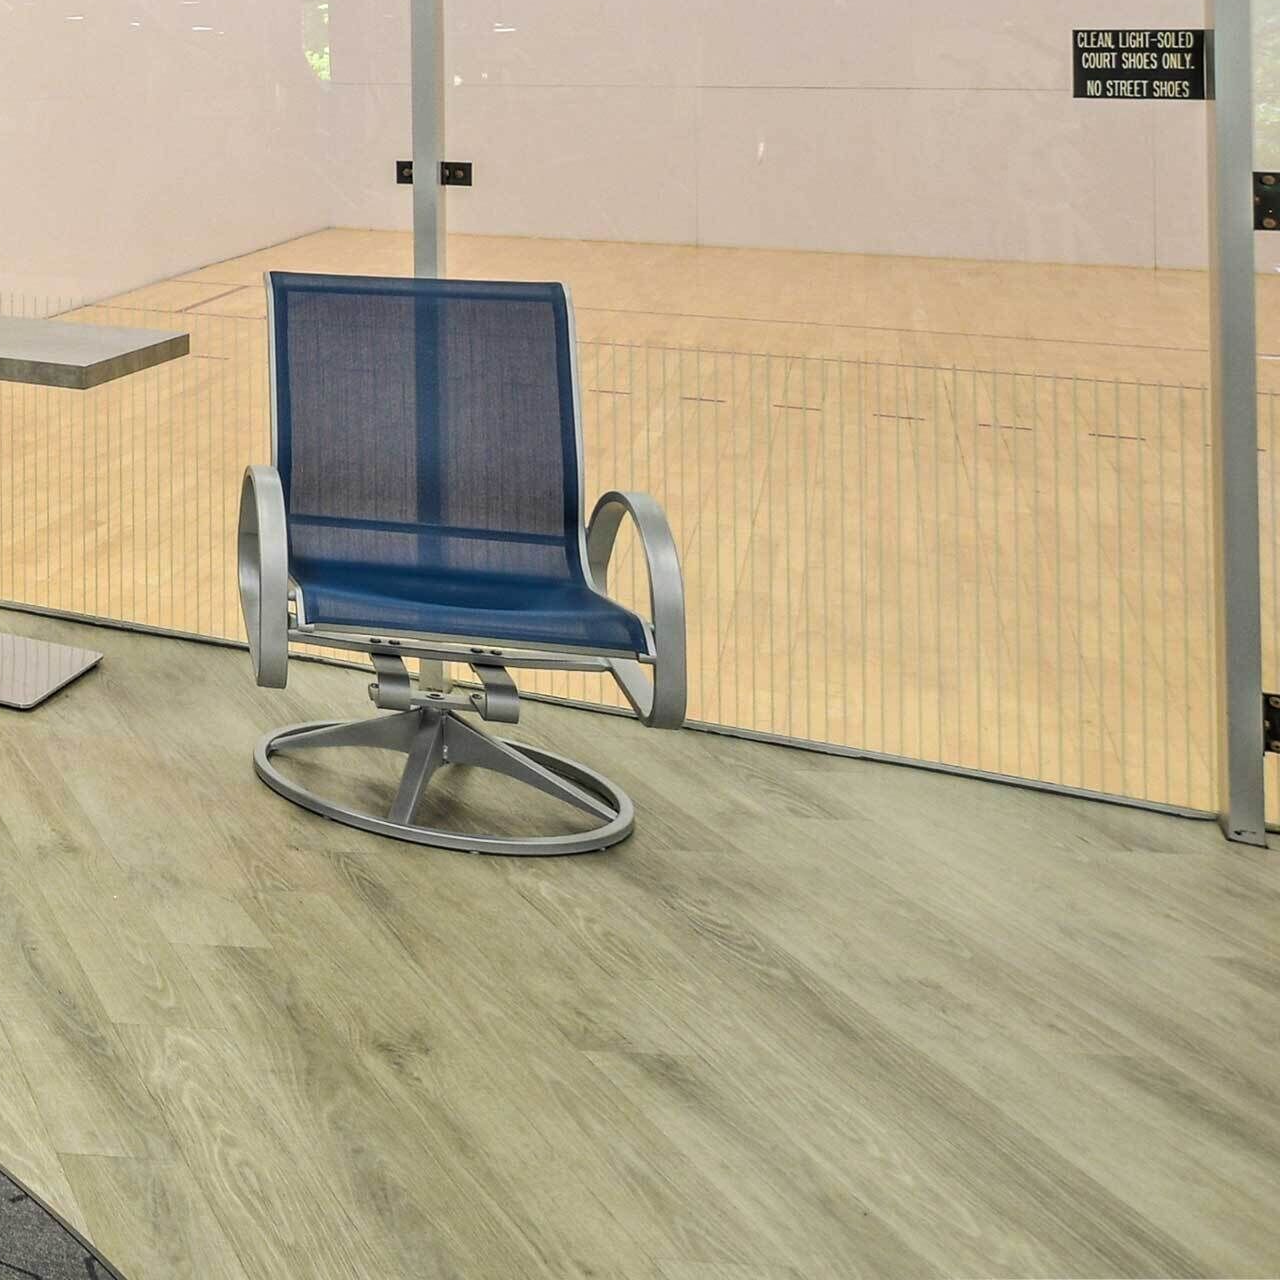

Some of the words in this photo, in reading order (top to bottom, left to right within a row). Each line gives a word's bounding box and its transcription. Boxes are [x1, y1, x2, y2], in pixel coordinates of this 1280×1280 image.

[1077, 32, 1115, 49] CLEAN,
[1119, 31, 1194, 49] LIGHT-SOLED
[1082, 52, 1118, 69] COURT
[1121, 52, 1158, 70] SHOES
[1162, 53, 1195, 69] ONLY.
[1086, 80, 1102, 96] NO
[1106, 80, 1148, 97] STREET
[1153, 80, 1190, 98] SHOES
